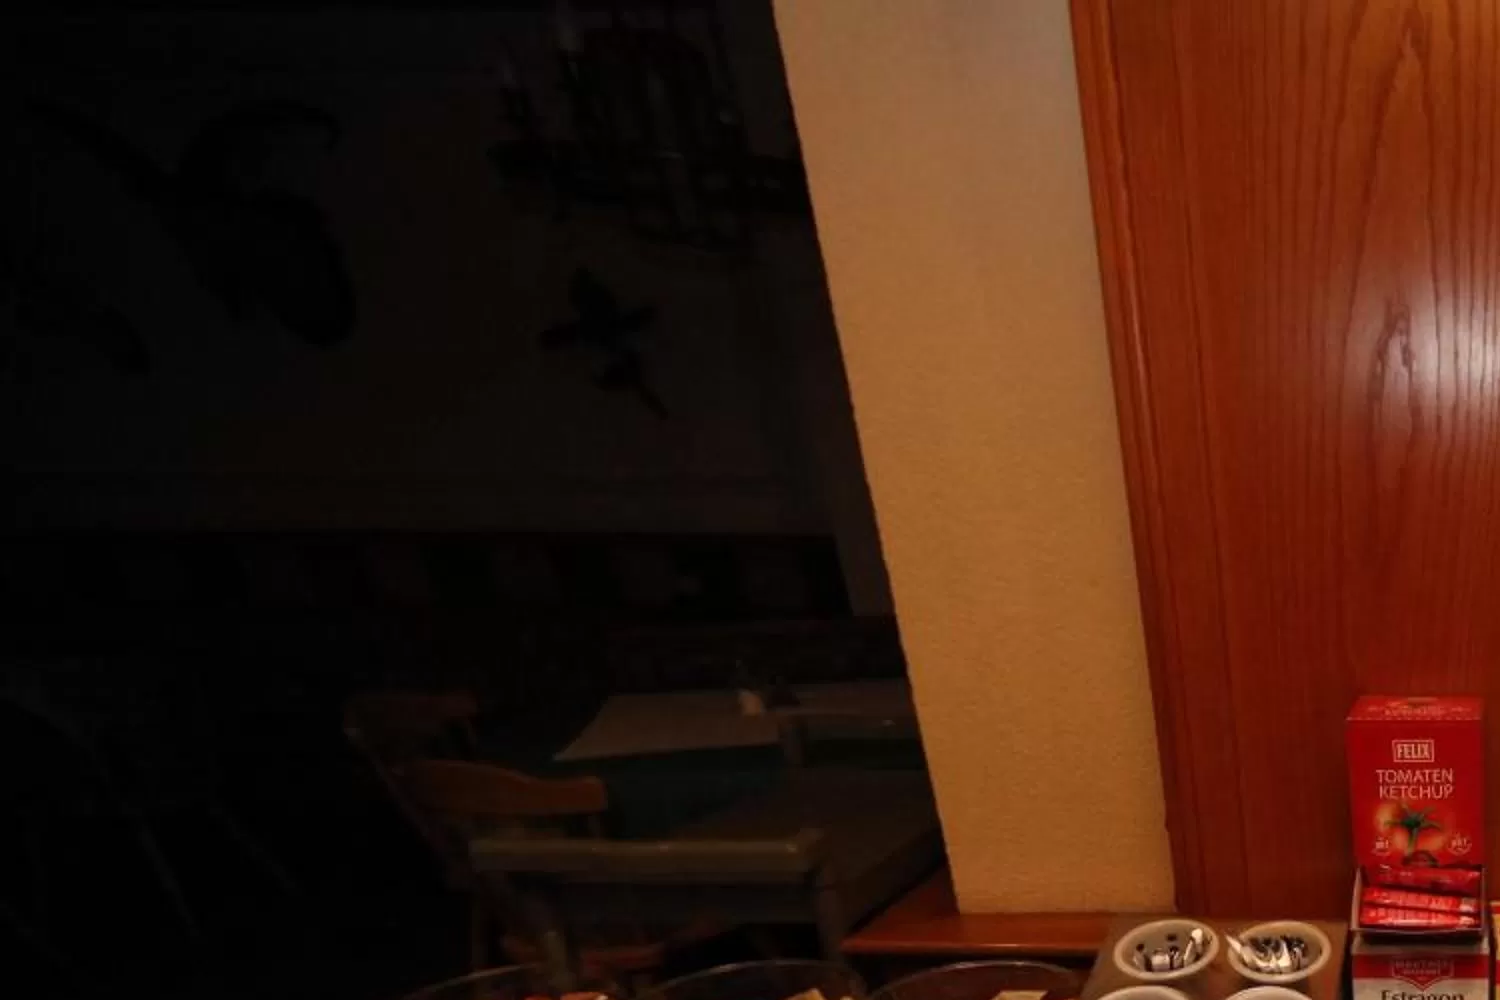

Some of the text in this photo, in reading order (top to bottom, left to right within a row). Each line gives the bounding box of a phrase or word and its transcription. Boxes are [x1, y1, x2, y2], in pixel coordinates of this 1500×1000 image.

[1396, 743, 1430, 759] FELIX
[1375, 768, 1454, 784] TOMATEN
[1379, 783, 1454, 800] KETCHUP
